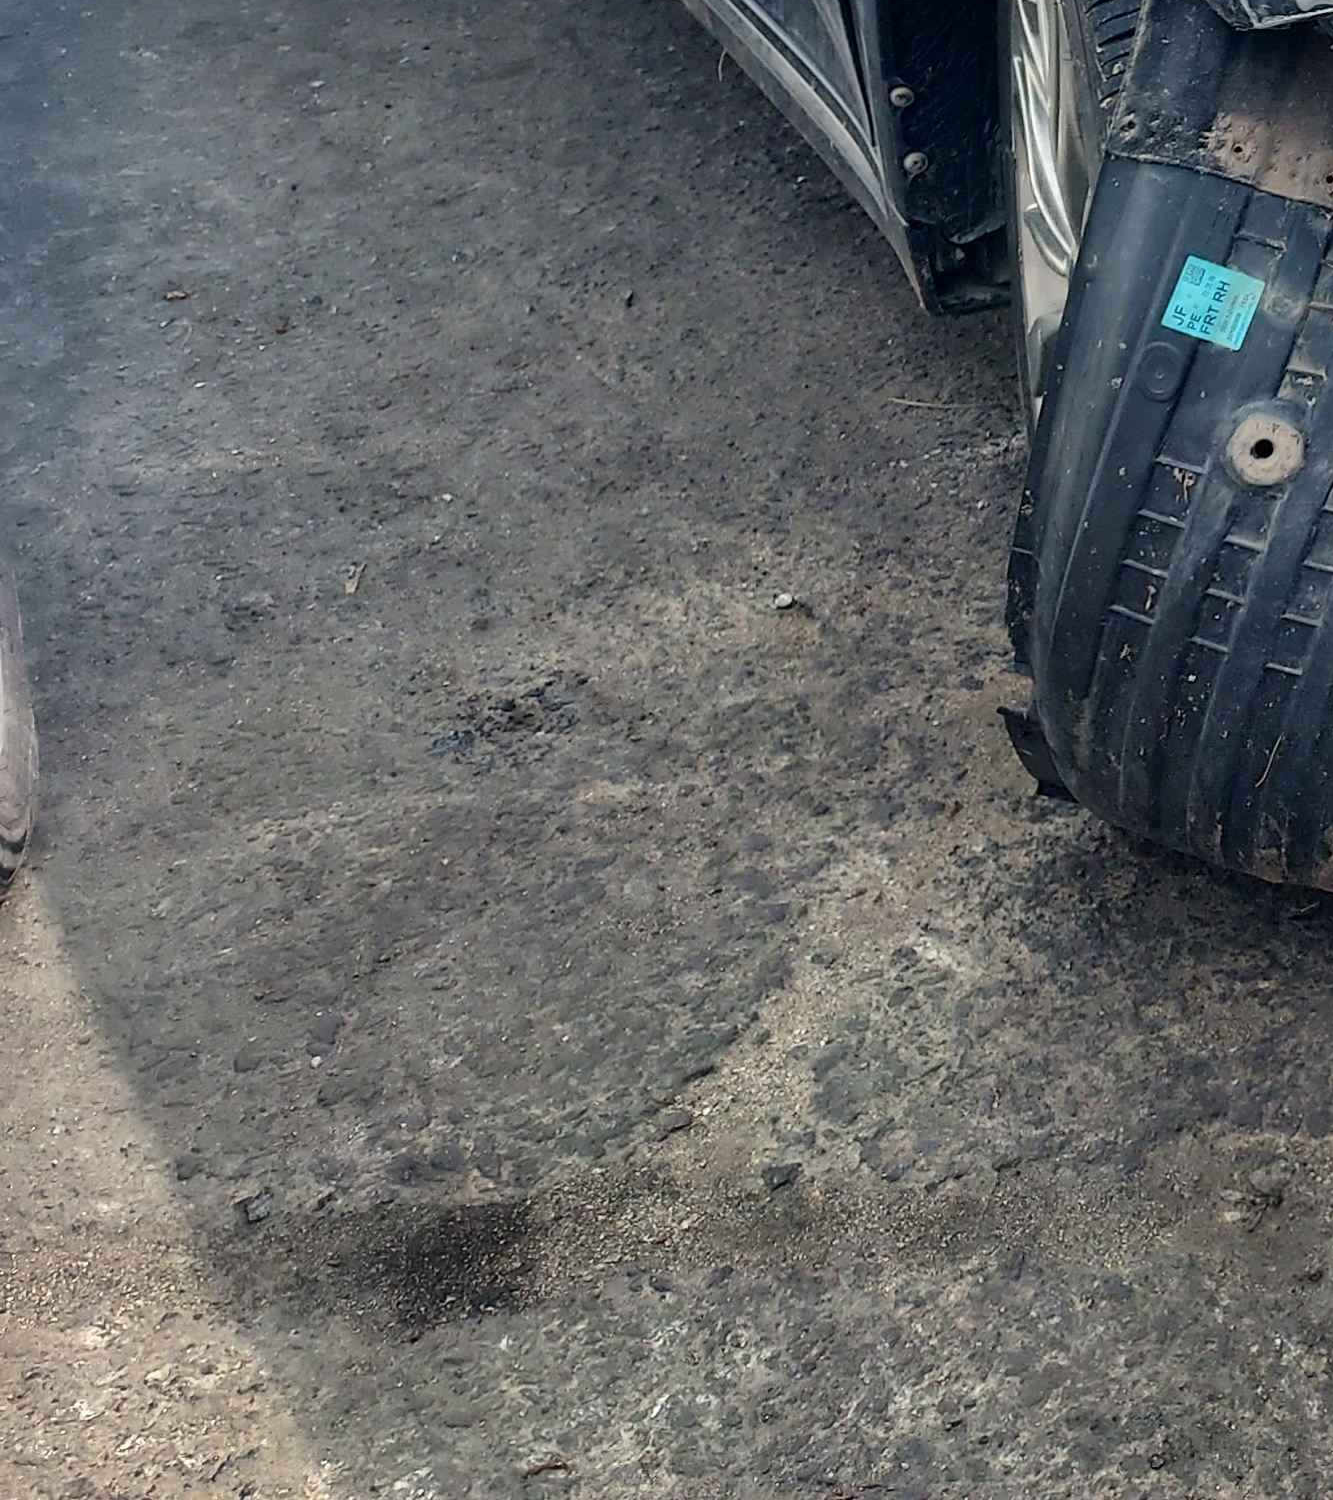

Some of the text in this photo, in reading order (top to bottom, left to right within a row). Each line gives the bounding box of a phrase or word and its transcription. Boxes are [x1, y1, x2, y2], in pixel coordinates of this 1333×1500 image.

[1171, 304, 1187, 326] JF
[1200, 304, 1220, 335] FRT
[1213, 280, 1231, 303] RH
[1187, 312, 1202, 330] PE
